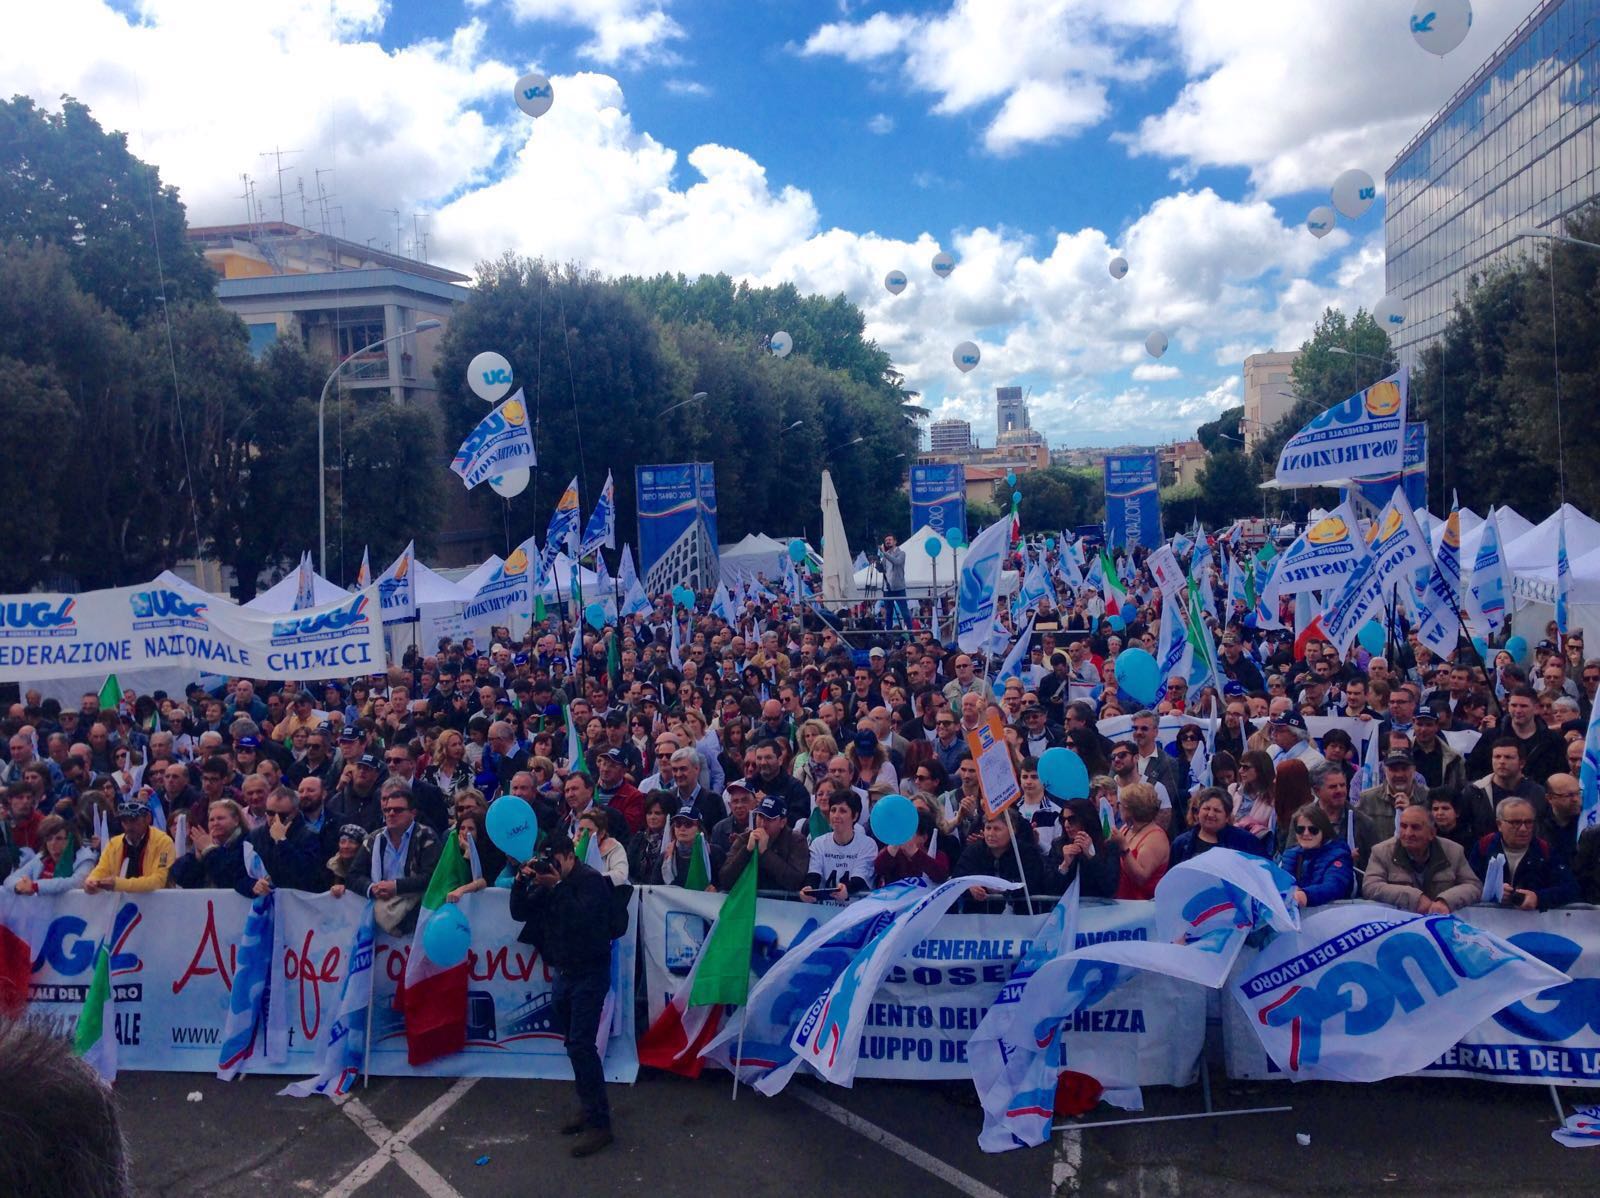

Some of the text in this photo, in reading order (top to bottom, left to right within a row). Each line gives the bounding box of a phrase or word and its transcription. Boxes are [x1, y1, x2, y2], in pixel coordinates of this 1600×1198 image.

[523, 84, 552, 101] UGL
[1359, 186, 1376, 200] UG
[7, 597, 76, 629] UGL
[299, 594, 369, 634] UGL
[343, 627, 369, 637] LAVORO
[0, 635, 372, 671] EDERAZIONE NAZIONALE CHIMICI
[911, 938, 1013, 961] GENERALE
[1310, 944, 1339, 968] DEL
[1250, 957, 1309, 994] LAVORO
[58, 988, 82, 1001] DEL
[1257, 930, 1459, 1072] UGL
[1529, 1048, 1574, 1073] DEL
